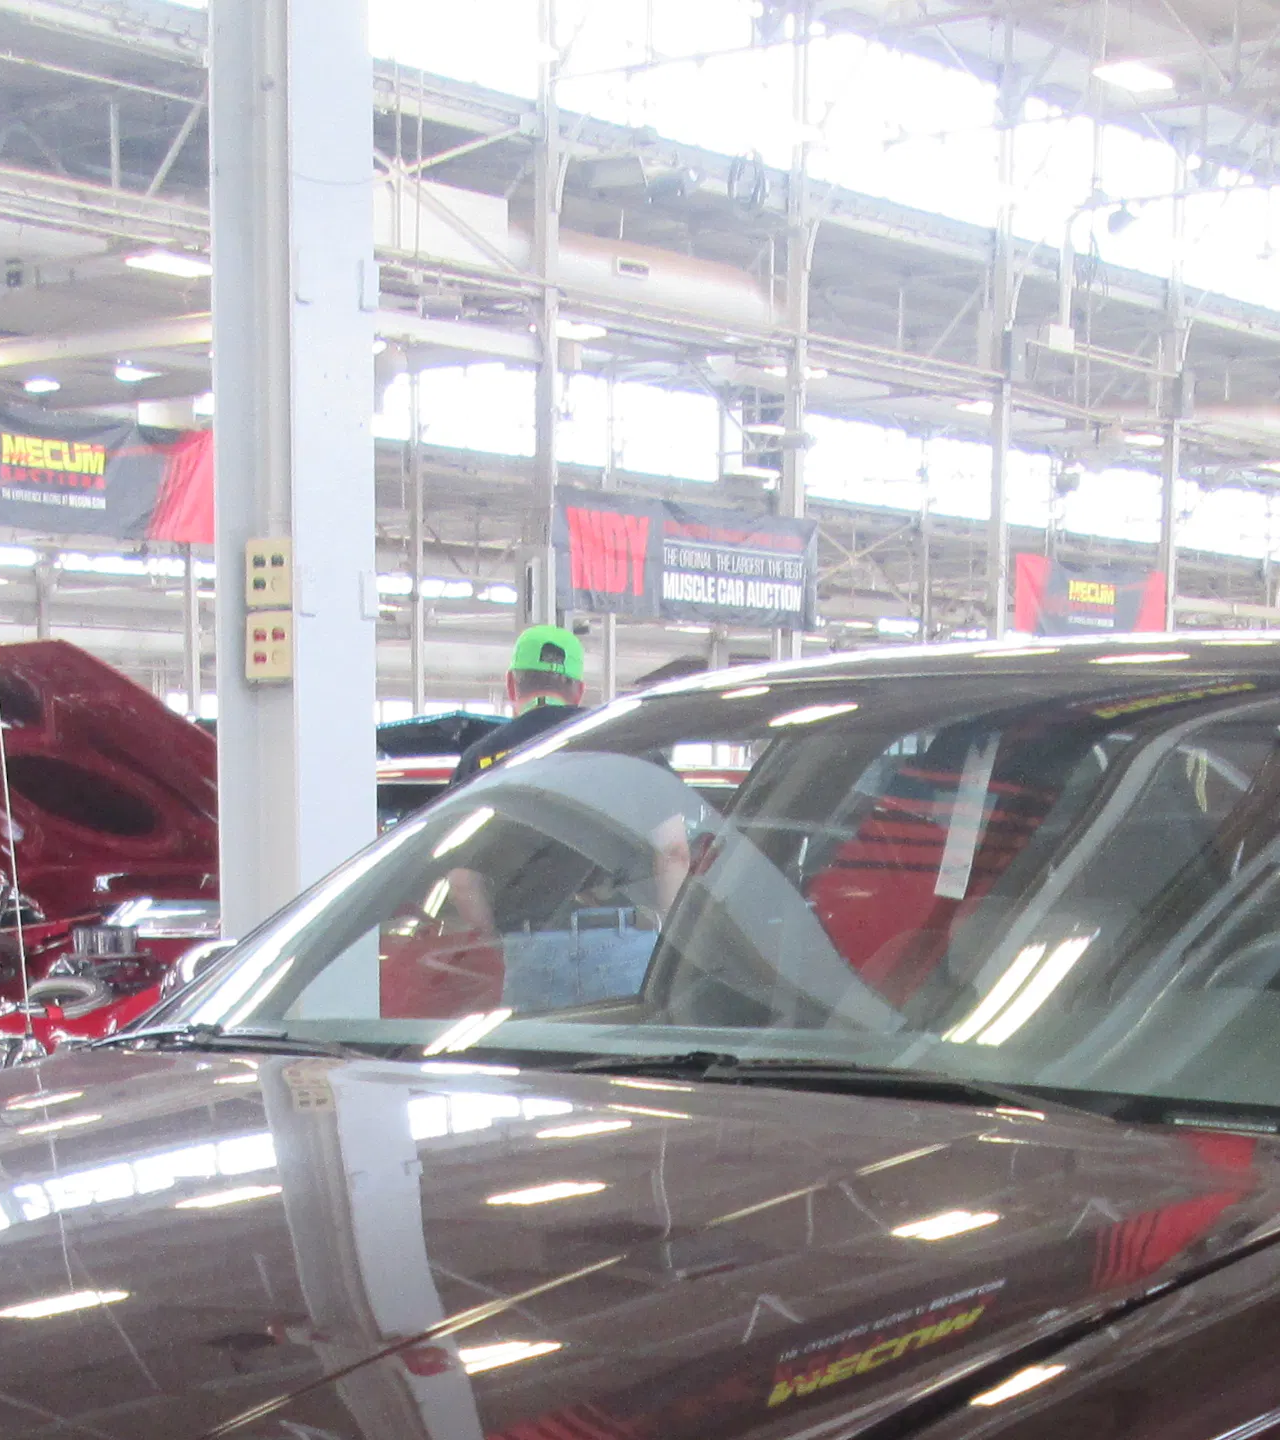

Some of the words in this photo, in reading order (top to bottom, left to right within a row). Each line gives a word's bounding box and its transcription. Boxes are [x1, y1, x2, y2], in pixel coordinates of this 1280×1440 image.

[1, 432, 107, 476] MECUM
[566, 505, 650, 597] INDY
[663, 571, 716, 604] MUSCLE
[716, 576, 745, 608] CAR
[745, 579, 802, 613] AUCTION
